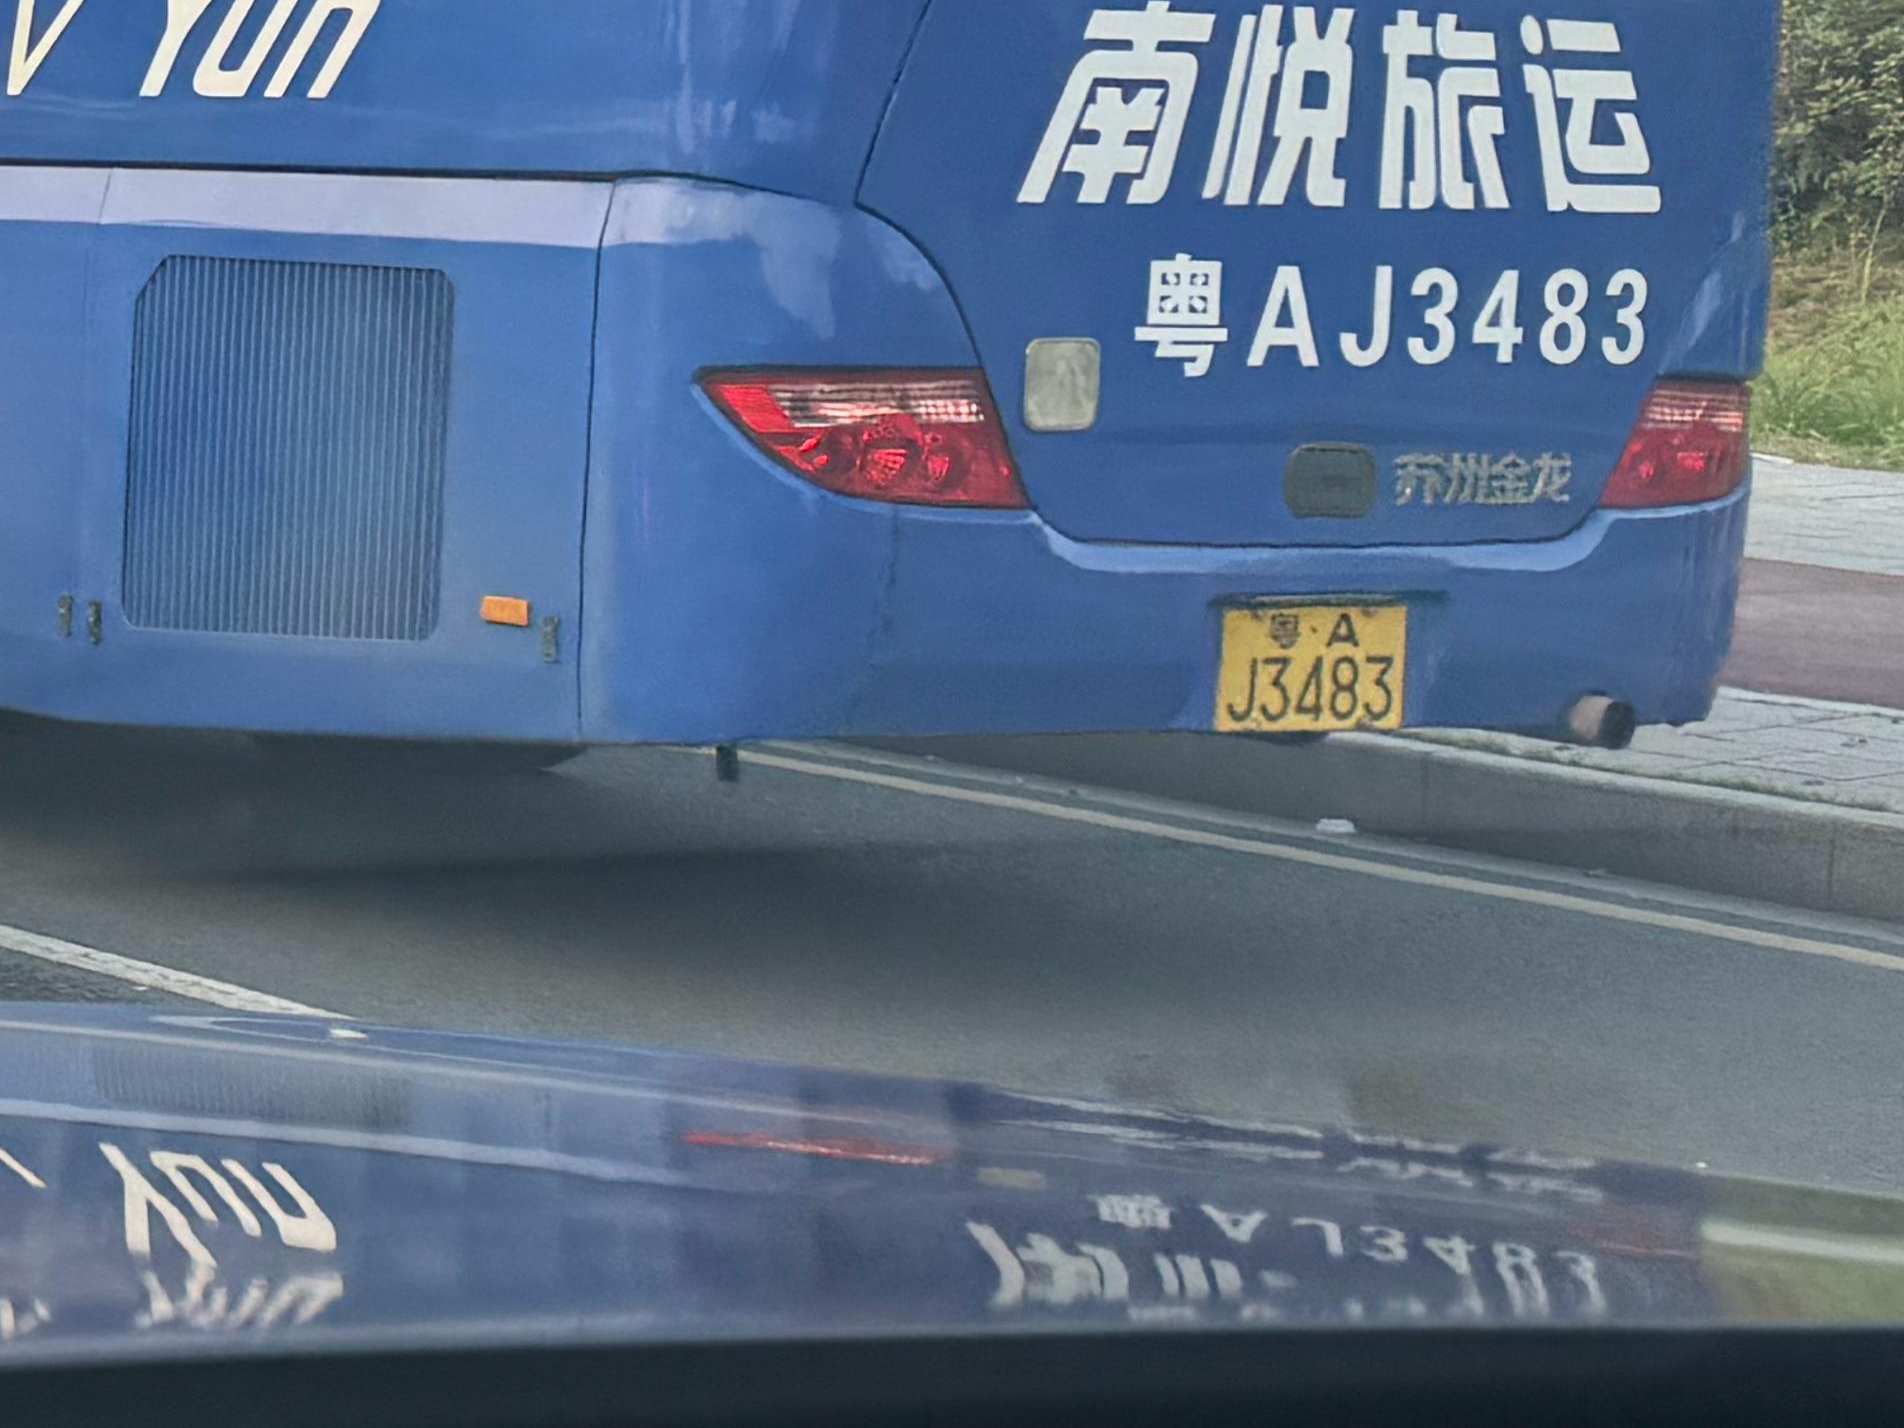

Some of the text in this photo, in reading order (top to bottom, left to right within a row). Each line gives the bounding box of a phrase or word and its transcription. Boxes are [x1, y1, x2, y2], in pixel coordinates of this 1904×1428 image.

[1015, 0, 1663, 214] 南悦旅运
[1133, 252, 1649, 378] 粤AJ3483
[1226, 655, 1395, 723] J3483
